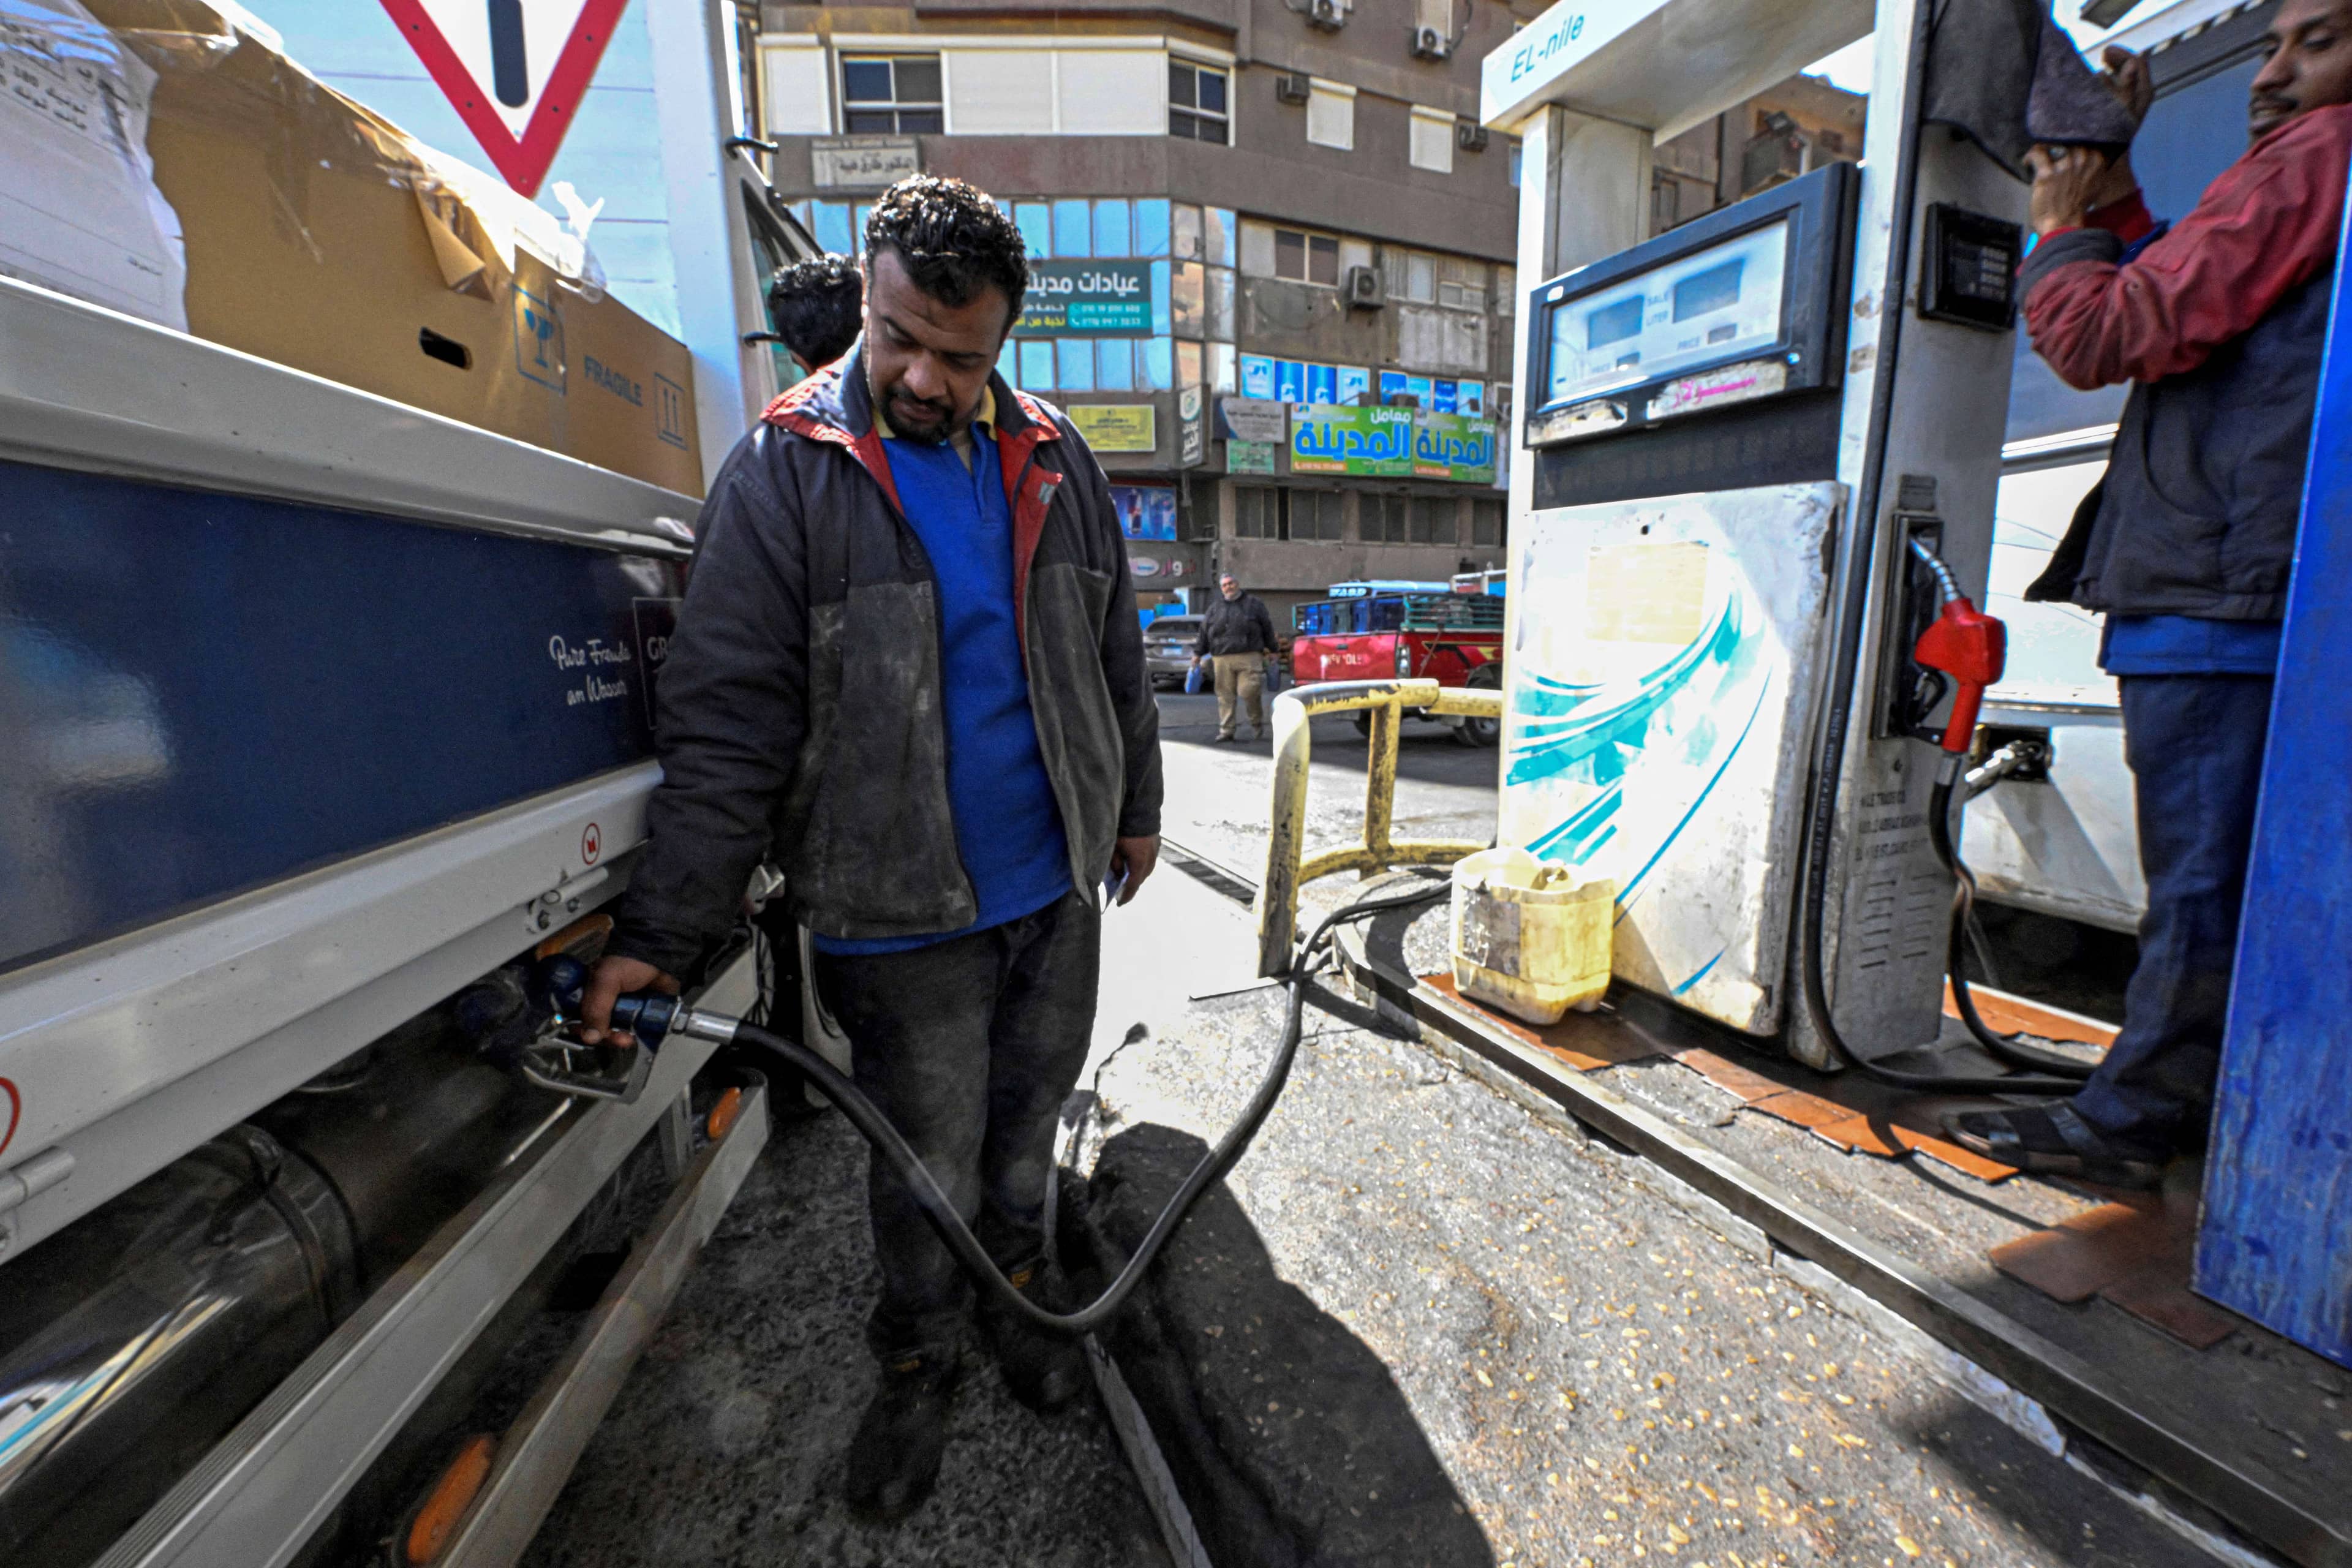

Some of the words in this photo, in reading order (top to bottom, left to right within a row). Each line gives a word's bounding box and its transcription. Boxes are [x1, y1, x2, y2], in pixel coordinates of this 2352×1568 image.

[1511, 15, 1585, 83] EL-nile
[1077, 271, 1140, 297] عيادات
[584, 355, 643, 407] FRAGILE
[1370, 409, 1411, 424] معامل
[1295, 423, 1410, 461] المدينة
[1416, 428, 1494, 467] المدينة
[549, 635, 586, 670] Pure
[567, 690, 586, 706] an
